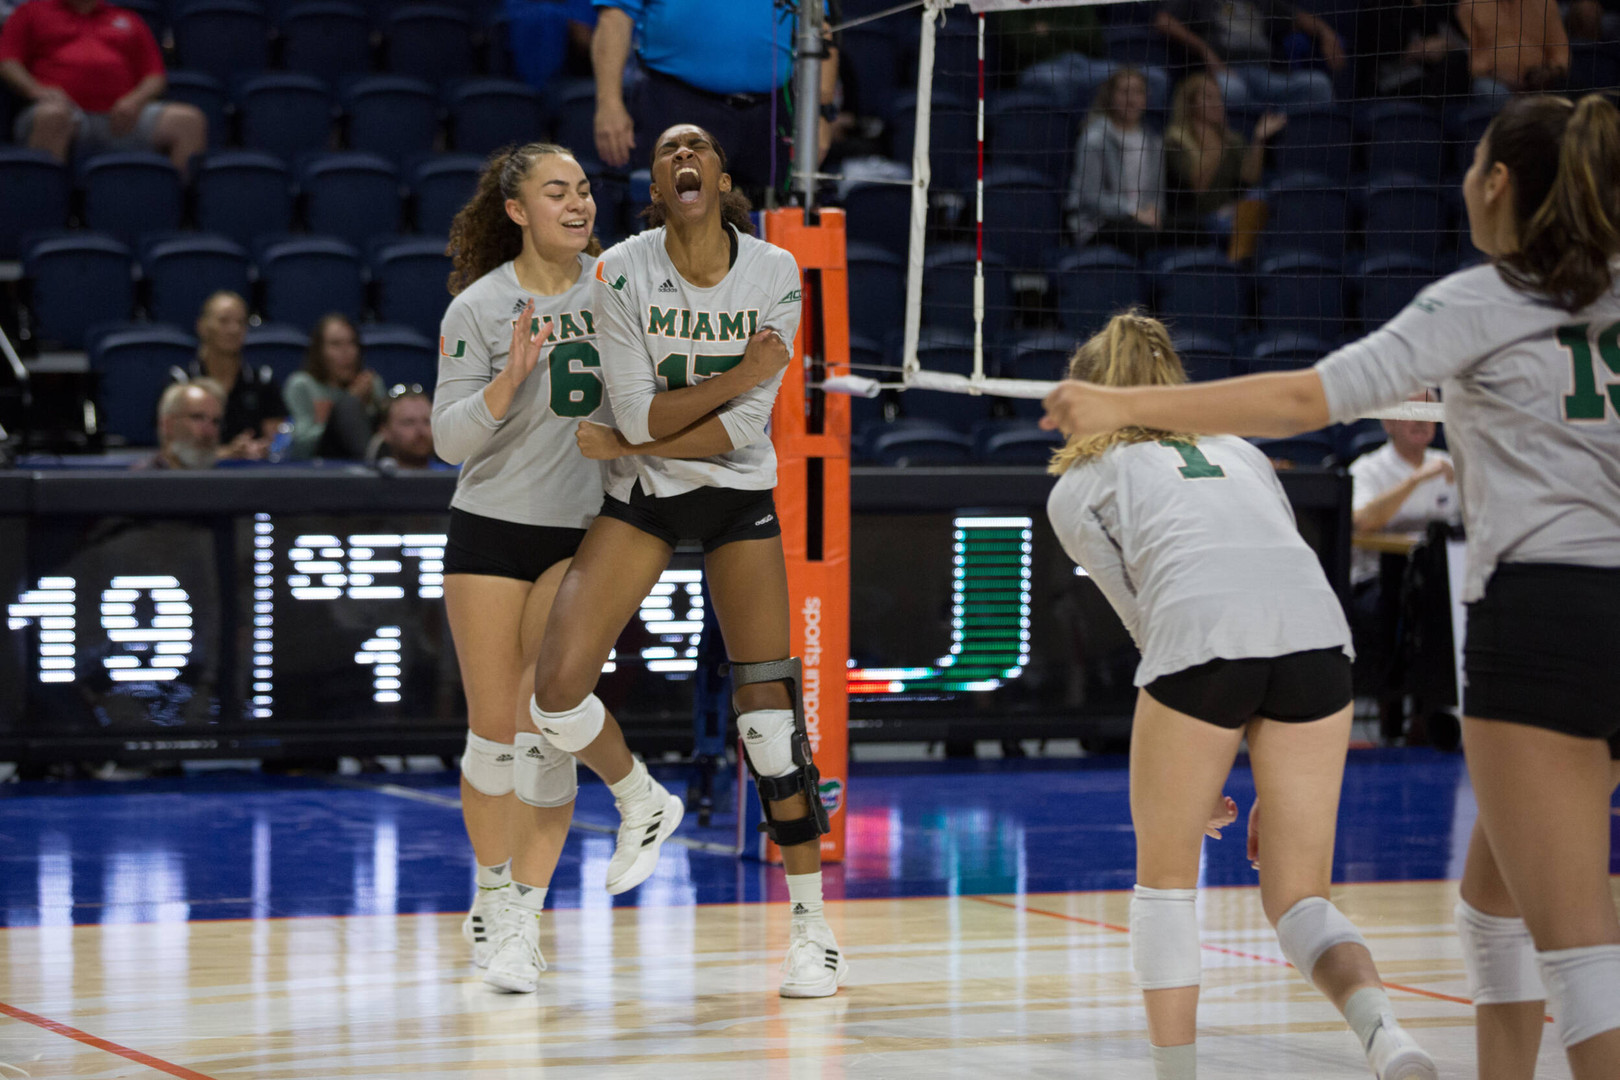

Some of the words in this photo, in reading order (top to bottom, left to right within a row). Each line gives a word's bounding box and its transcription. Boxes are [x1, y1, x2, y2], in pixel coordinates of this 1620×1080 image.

[646, 304, 760, 343] MIAMI
[777, 289, 802, 304] AC
[548, 340, 603, 418] 6
[1157, 438, 1227, 481] 1
[287, 534, 448, 600] SET
[7, 575, 194, 683] 19
[600, 569, 705, 673] 9
[801, 595, 823, 667] sports
[354, 625, 401, 702] 1
[803, 668, 822, 754] imports
